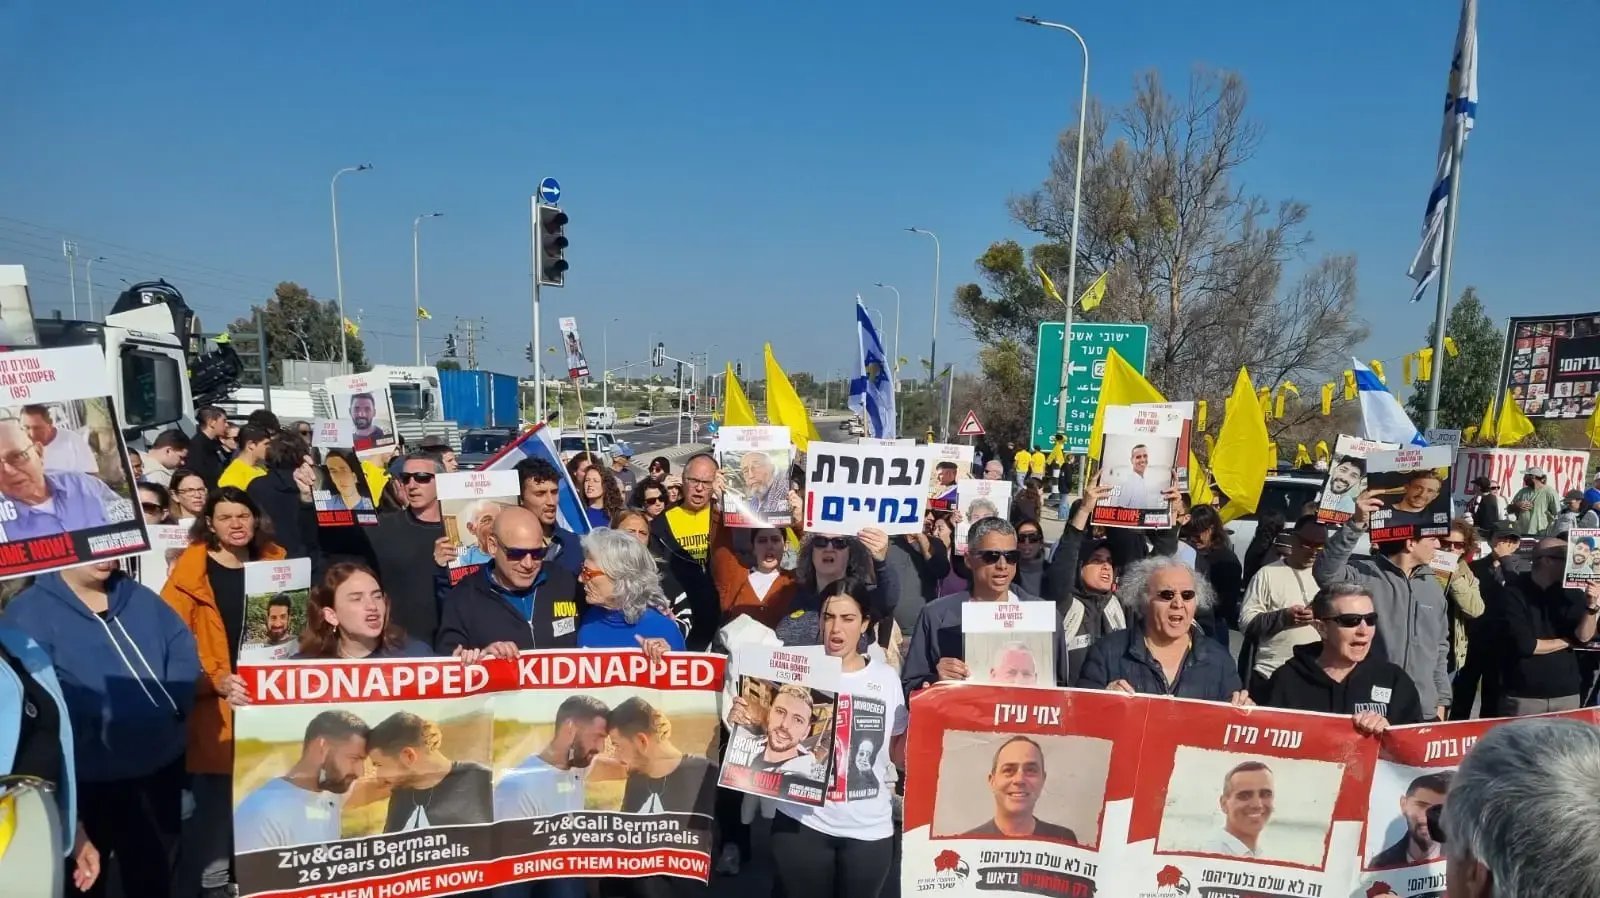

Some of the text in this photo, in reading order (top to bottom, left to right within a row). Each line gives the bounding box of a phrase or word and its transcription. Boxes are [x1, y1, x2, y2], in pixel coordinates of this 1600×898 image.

[1100, 332, 1130, 342] ישובי
[1081, 346, 1103, 355] סער
[19, 369, 56, 385] COOPER
[10, 385, 31, 399] (85)
[1071, 409, 1095, 419] Sa'a
[1066, 422, 1094, 432] Eshk
[811, 454, 926, 486] ובחרת
[806, 491, 919, 527] בחיים!
[28, 530, 76, 561] NOW!
[257, 664, 489, 700] KIDNAPPED
[518, 656, 715, 687] KIDNAPPED
[853, 699, 885, 715] MURDERED
[994, 703, 1061, 725] צחי עידן
[1223, 723, 1304, 749] עמרי מירן
[1424, 738, 1459, 763] ברמן
[533, 815, 680, 836] Ziv&Gali Berman
[548, 830, 700, 847] 26 years old Israelis
[277, 834, 448, 869] Ziv&Gali Berman
[298, 843, 470, 884] 26 years old Israelis
[513, 856, 709, 876] BRING THEM HOME NOW!
[979, 850, 1099, 877] זה לא שלם בלעדיהם!
[378, 874, 431, 896] HOME
[435, 870, 484, 886] NOW!
[985, 872, 1019, 884] בראש
[1201, 869, 1323, 898] זה לא שלם בלעדיהם!
[1407, 872, 1447, 892] לעדיהם!
